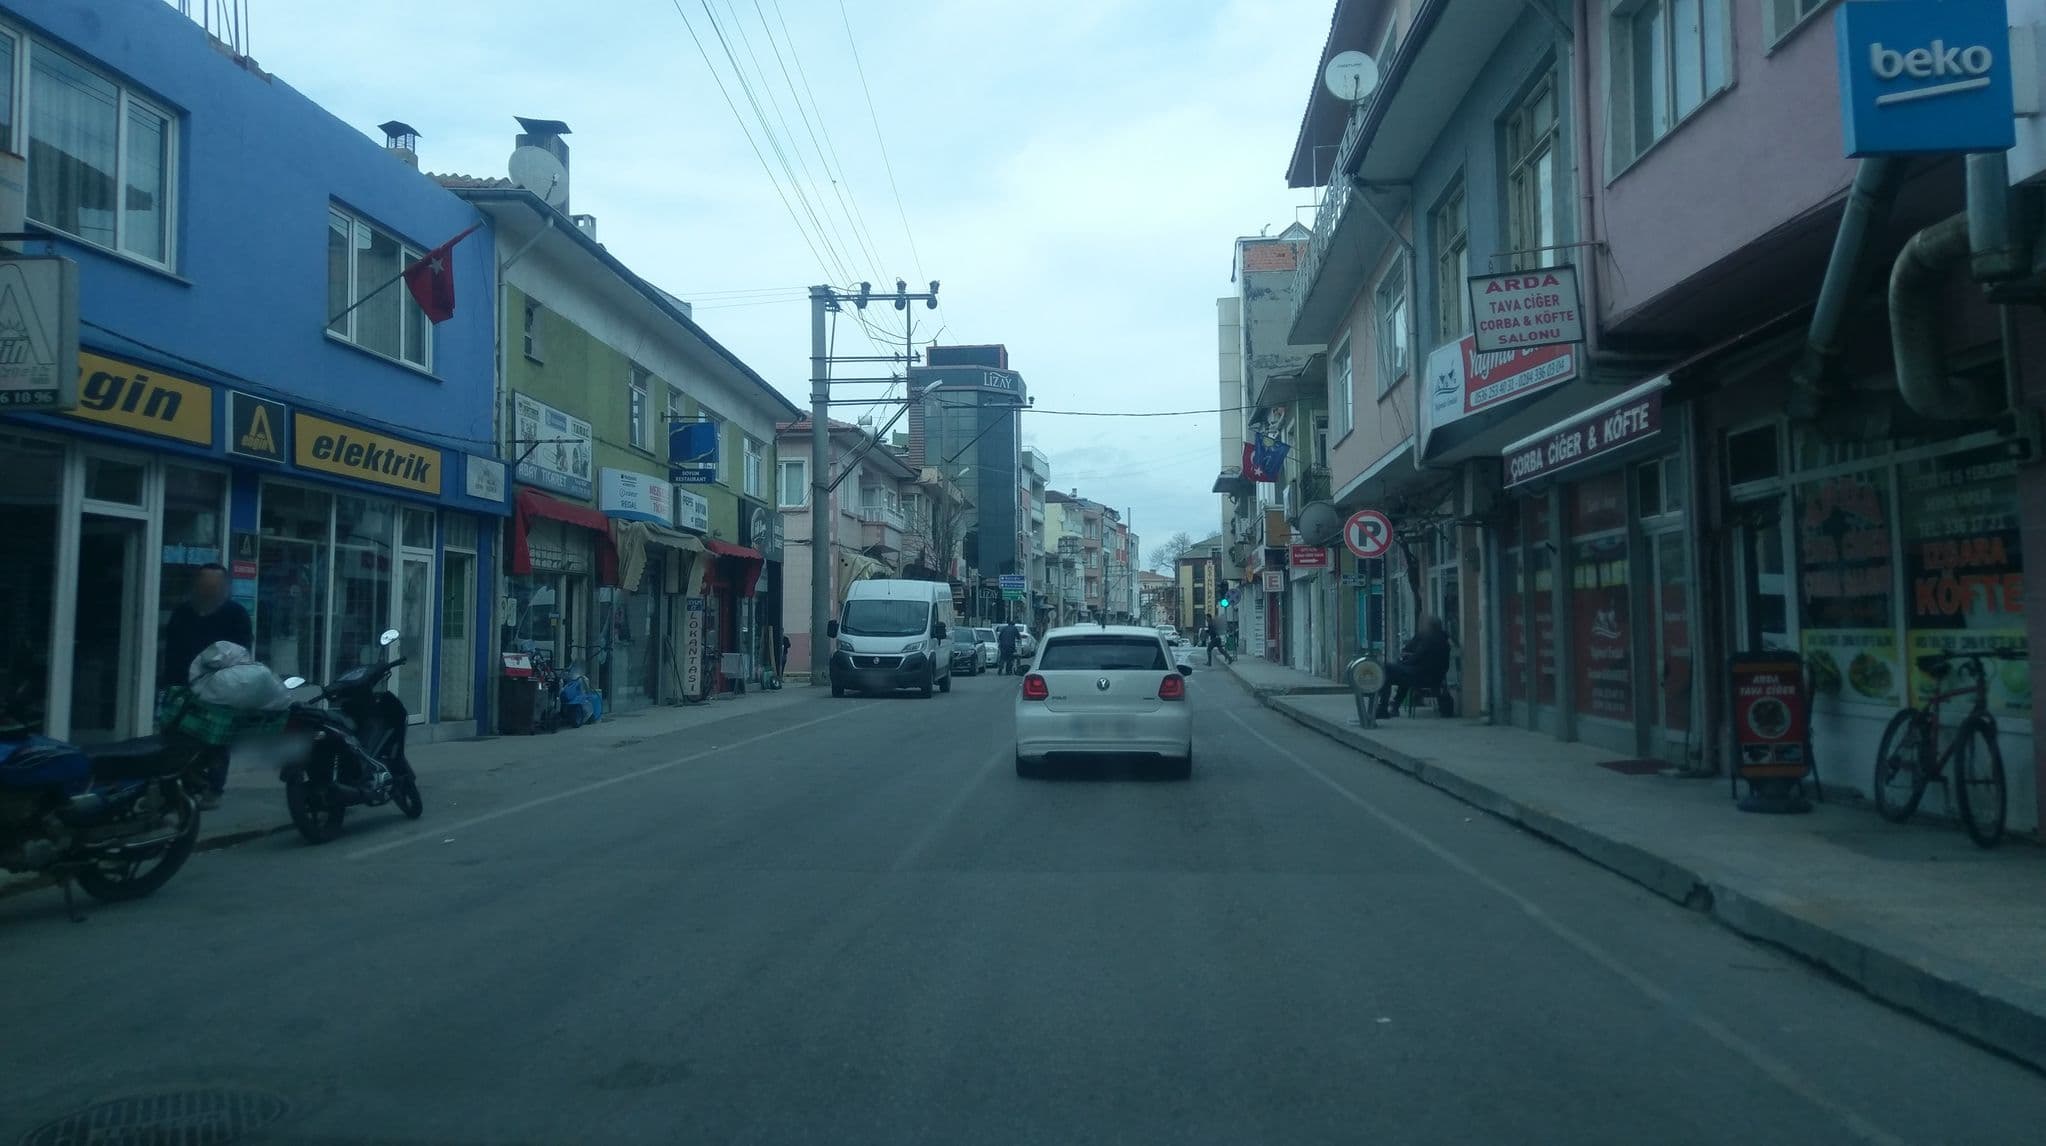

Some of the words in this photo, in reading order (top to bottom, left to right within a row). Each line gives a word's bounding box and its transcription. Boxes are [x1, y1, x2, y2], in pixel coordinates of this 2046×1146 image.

[1869, 39, 1993, 79] beko
[1485, 273, 1561, 295] ARDA
[1488, 299, 1521, 314] TAVA
[1523, 315, 1532, 327] &
[1535, 309, 1575, 325] KÖFTE
[1498, 328, 1561, 345] SALONU
[79, 367, 183, 422] gin
[311, 434, 432, 484] elektrik
[1510, 448, 1544, 485] ÇORBA
[1547, 432, 1582, 465] CİĞER
[1587, 425, 1598, 450] &
[1603, 402, 1650, 444] KÖFTE
[1915, 570, 2025, 616] KÖFTE
[688, 611, 698, 691] LOKANTASI
